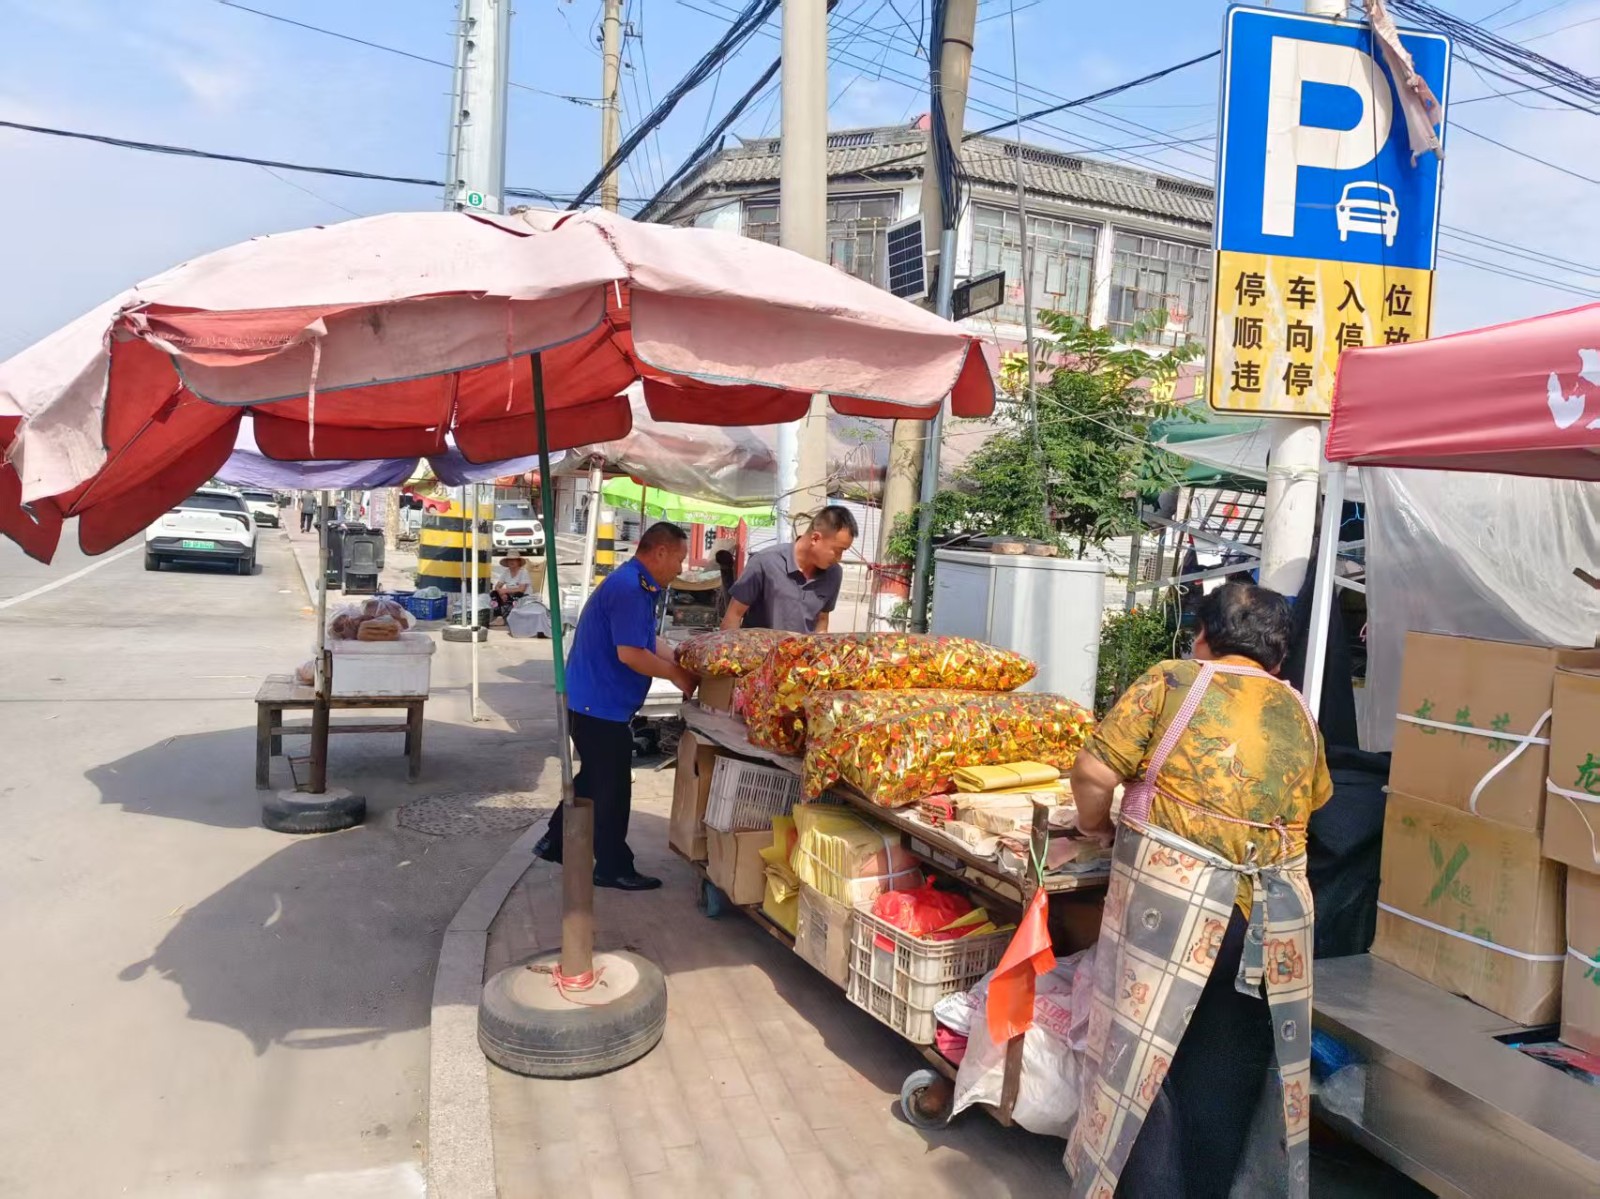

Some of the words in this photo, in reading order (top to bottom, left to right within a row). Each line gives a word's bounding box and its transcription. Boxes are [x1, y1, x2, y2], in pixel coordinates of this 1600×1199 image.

[1262, 36, 1393, 237] P
[1235, 272, 1412, 317] 停车入位
